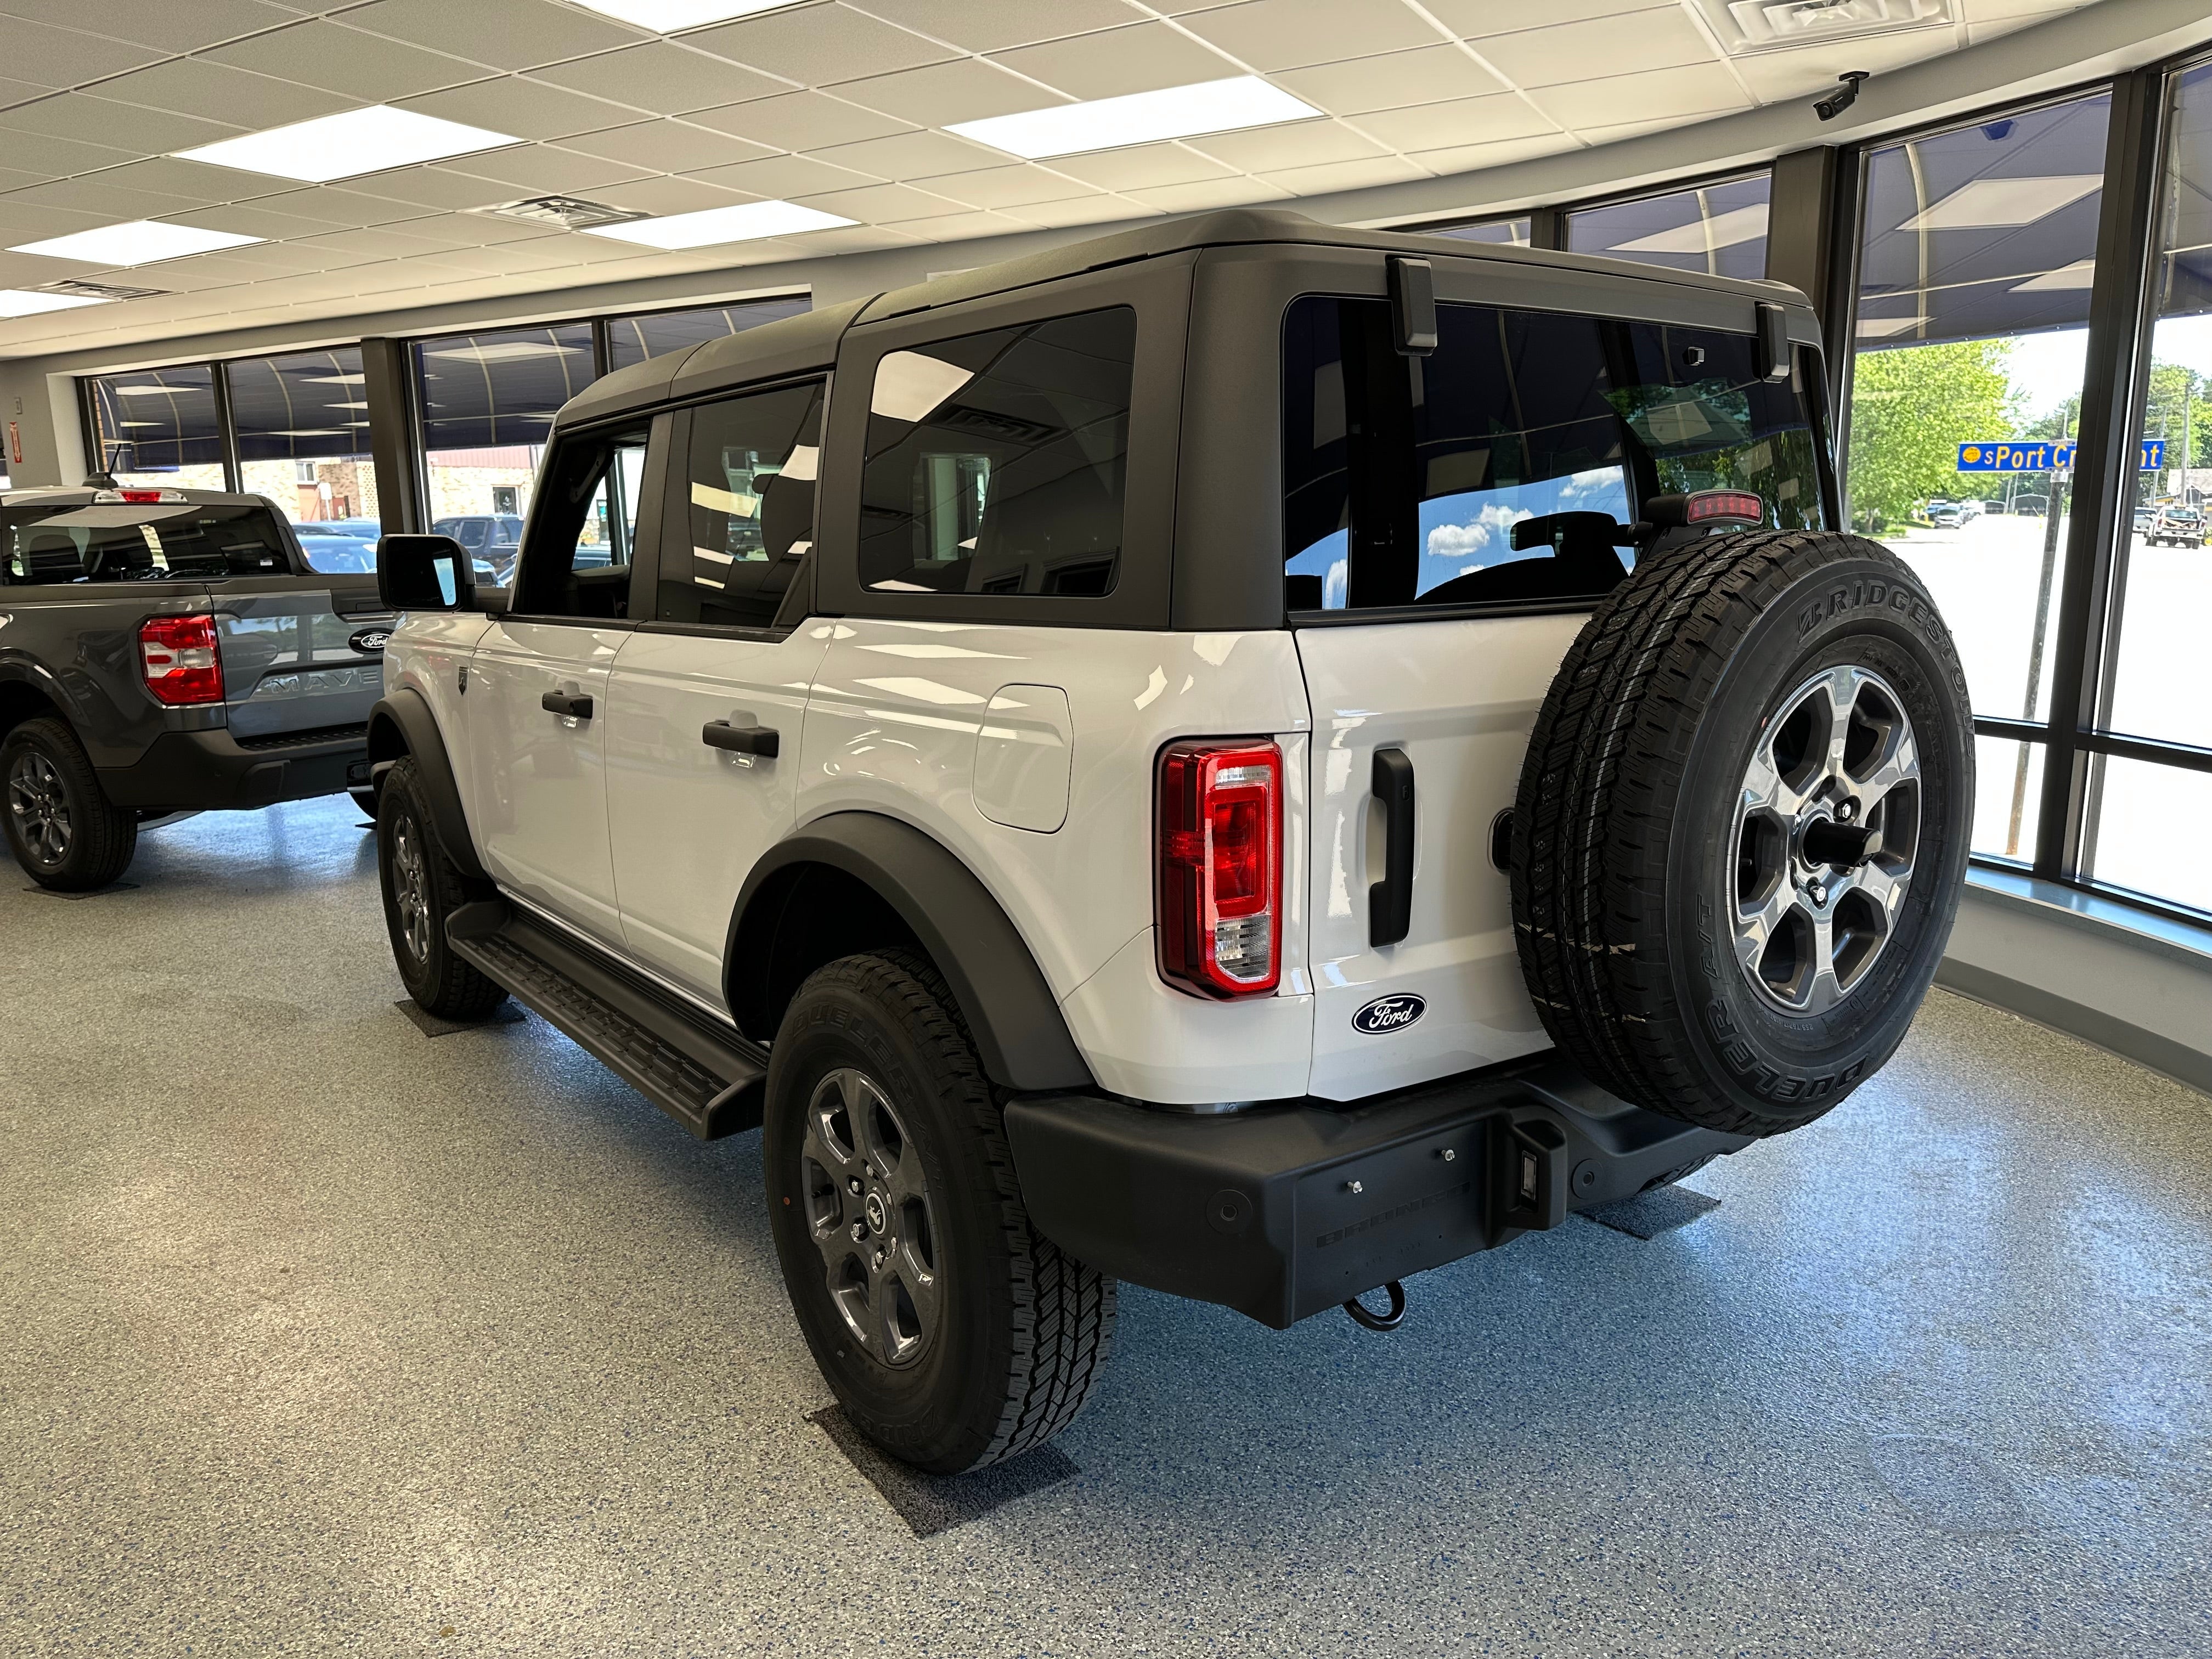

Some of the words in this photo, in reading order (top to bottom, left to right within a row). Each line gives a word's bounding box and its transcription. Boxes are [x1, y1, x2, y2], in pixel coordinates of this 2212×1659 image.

[368, 635, 388, 646] Ford
[1797, 580, 1975, 758] BRIDGESTONE
[793, 1002, 917, 1105] DUELER
[1369, 1001, 1414, 1029] Ford
[1706, 997, 1870, 1103] DUELER
[1317, 1181, 1471, 1249] BRONCO
